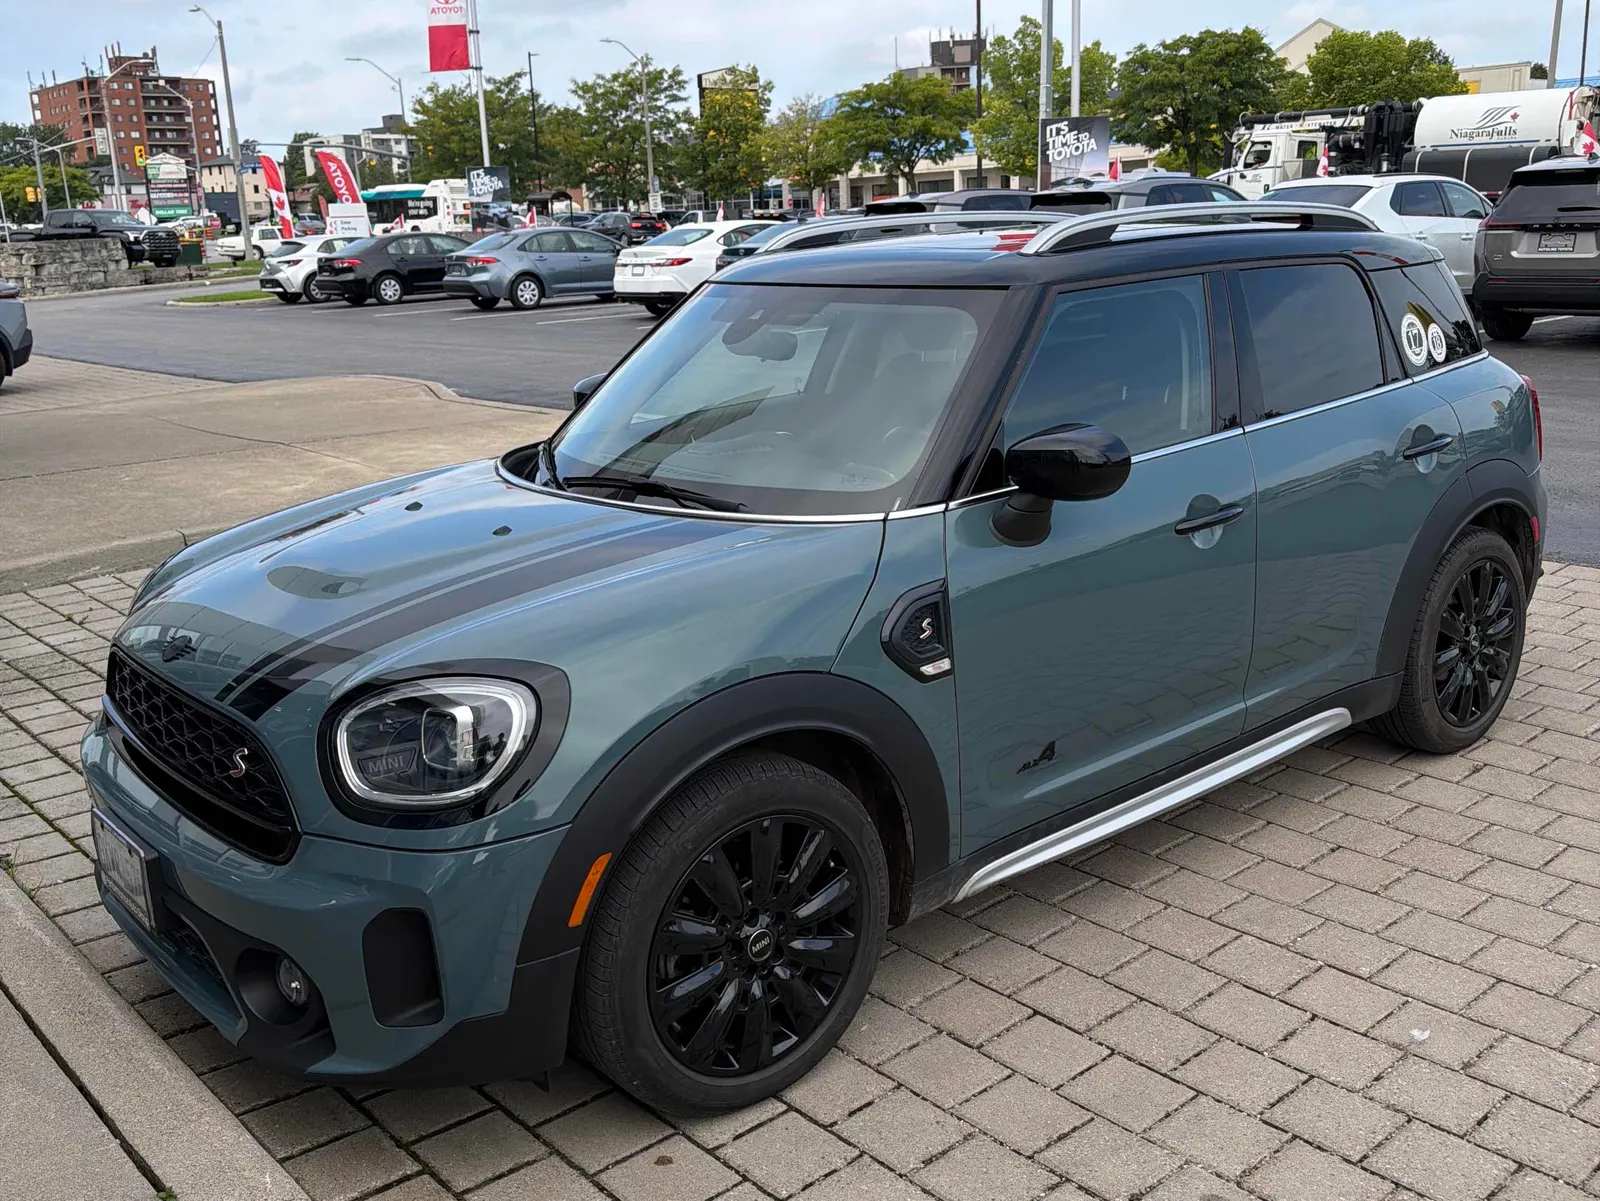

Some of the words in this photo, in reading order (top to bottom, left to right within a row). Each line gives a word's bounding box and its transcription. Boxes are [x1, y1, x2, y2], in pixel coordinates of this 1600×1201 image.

[1046, 121, 1069, 139] IT'S
[1046, 130, 1078, 150] TIME
[1078, 132, 1089, 142] TO
[1046, 138, 1097, 163] TOYOTA
[471, 176, 491, 187] TIME
[472, 180, 503, 196] TOYOTA
[420, 199, 433, 209] going
[1408, 328, 1420, 350] 17
[920, 618, 933, 639] S
[230, 748, 248, 778] S
[368, 755, 404, 773] MINI
[751, 936, 770, 954] MINI
